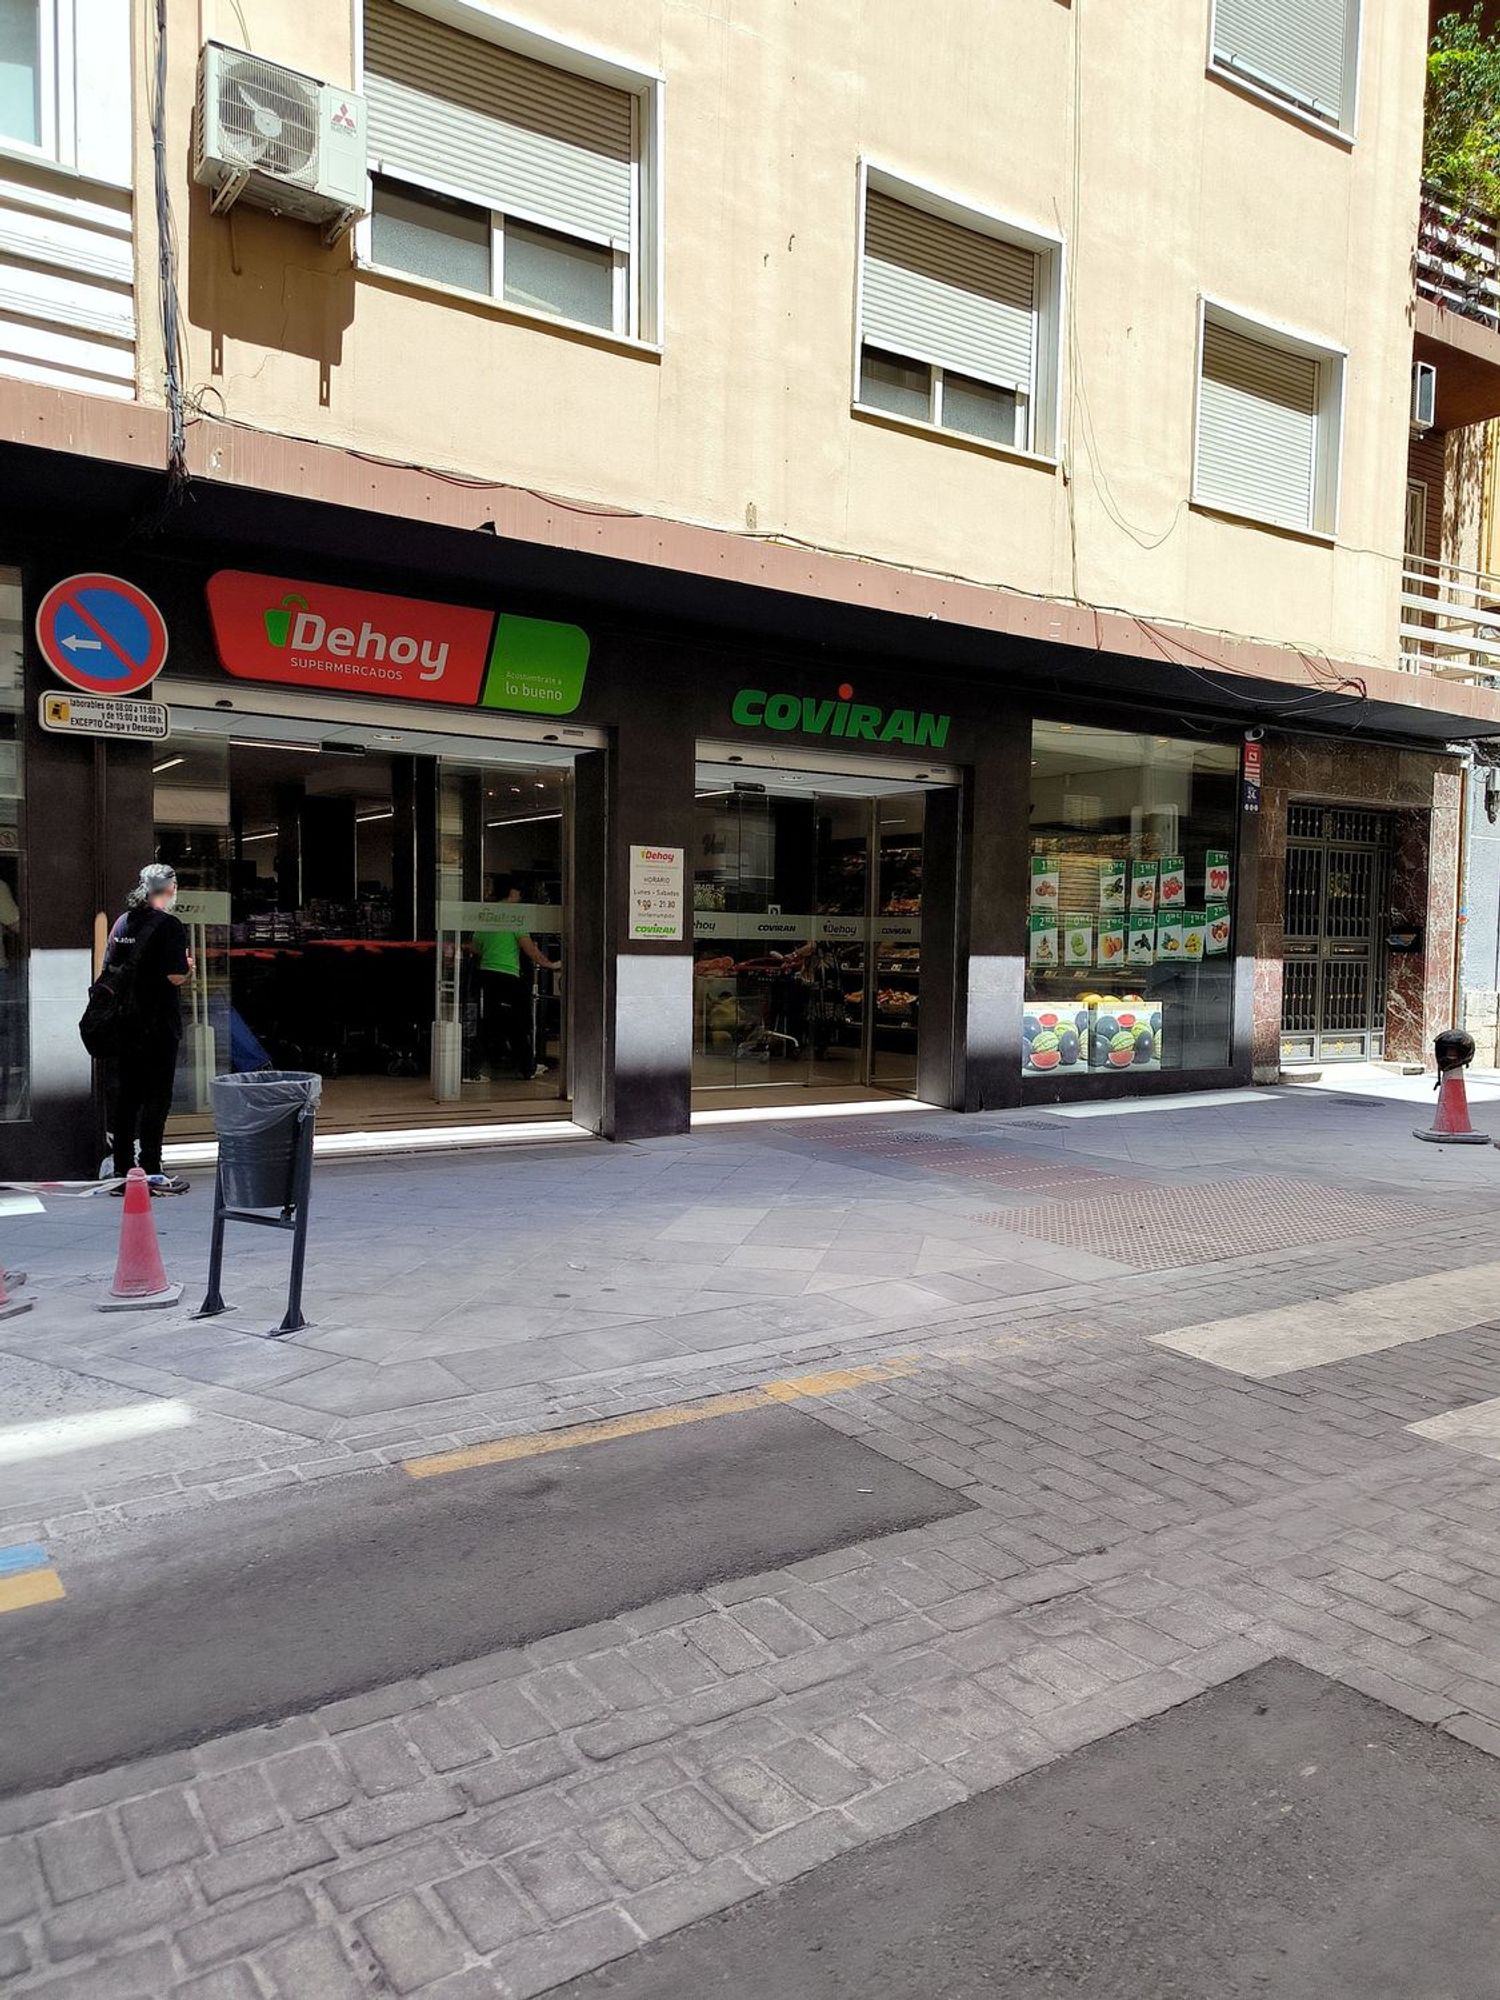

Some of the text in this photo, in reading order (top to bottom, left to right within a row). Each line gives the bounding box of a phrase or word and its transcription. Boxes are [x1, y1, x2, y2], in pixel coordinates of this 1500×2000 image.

[290, 612, 449, 682] Dehoy
[290, 657, 403, 680] SUPERMERCADOS
[506, 681, 563, 701] lo bueno
[70, 698, 105, 710] laborables
[106, 701, 114, 711] de
[134, 705, 138, 713] a
[101, 713, 106, 721] y
[106, 711, 115, 720] de
[732, 683, 950, 748] COVIRAN
[70, 718, 164, 734] EXCEPTO Carga y Descarga
[758, 924, 796, 933] COVIRAN
